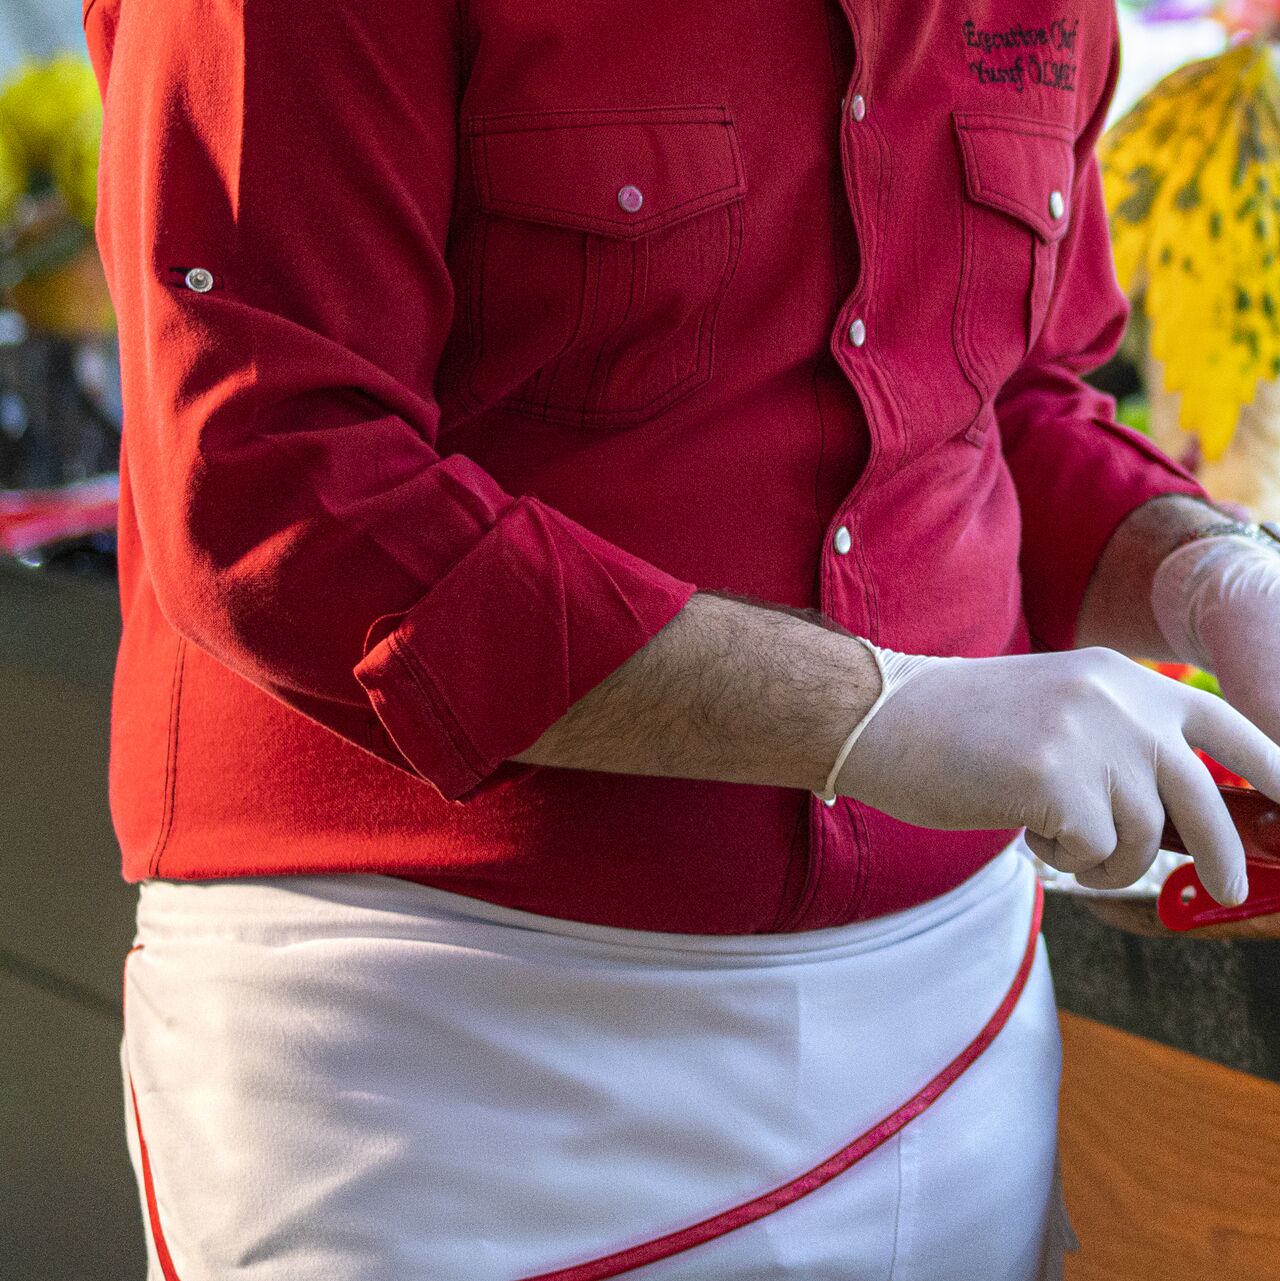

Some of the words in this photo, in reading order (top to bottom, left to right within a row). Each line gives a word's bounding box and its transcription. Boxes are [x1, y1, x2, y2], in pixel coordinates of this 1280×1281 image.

[963, 20, 1048, 53] Executive
[1050, 18, 1079, 59] Chef
[969, 56, 1024, 93] Yusuf
